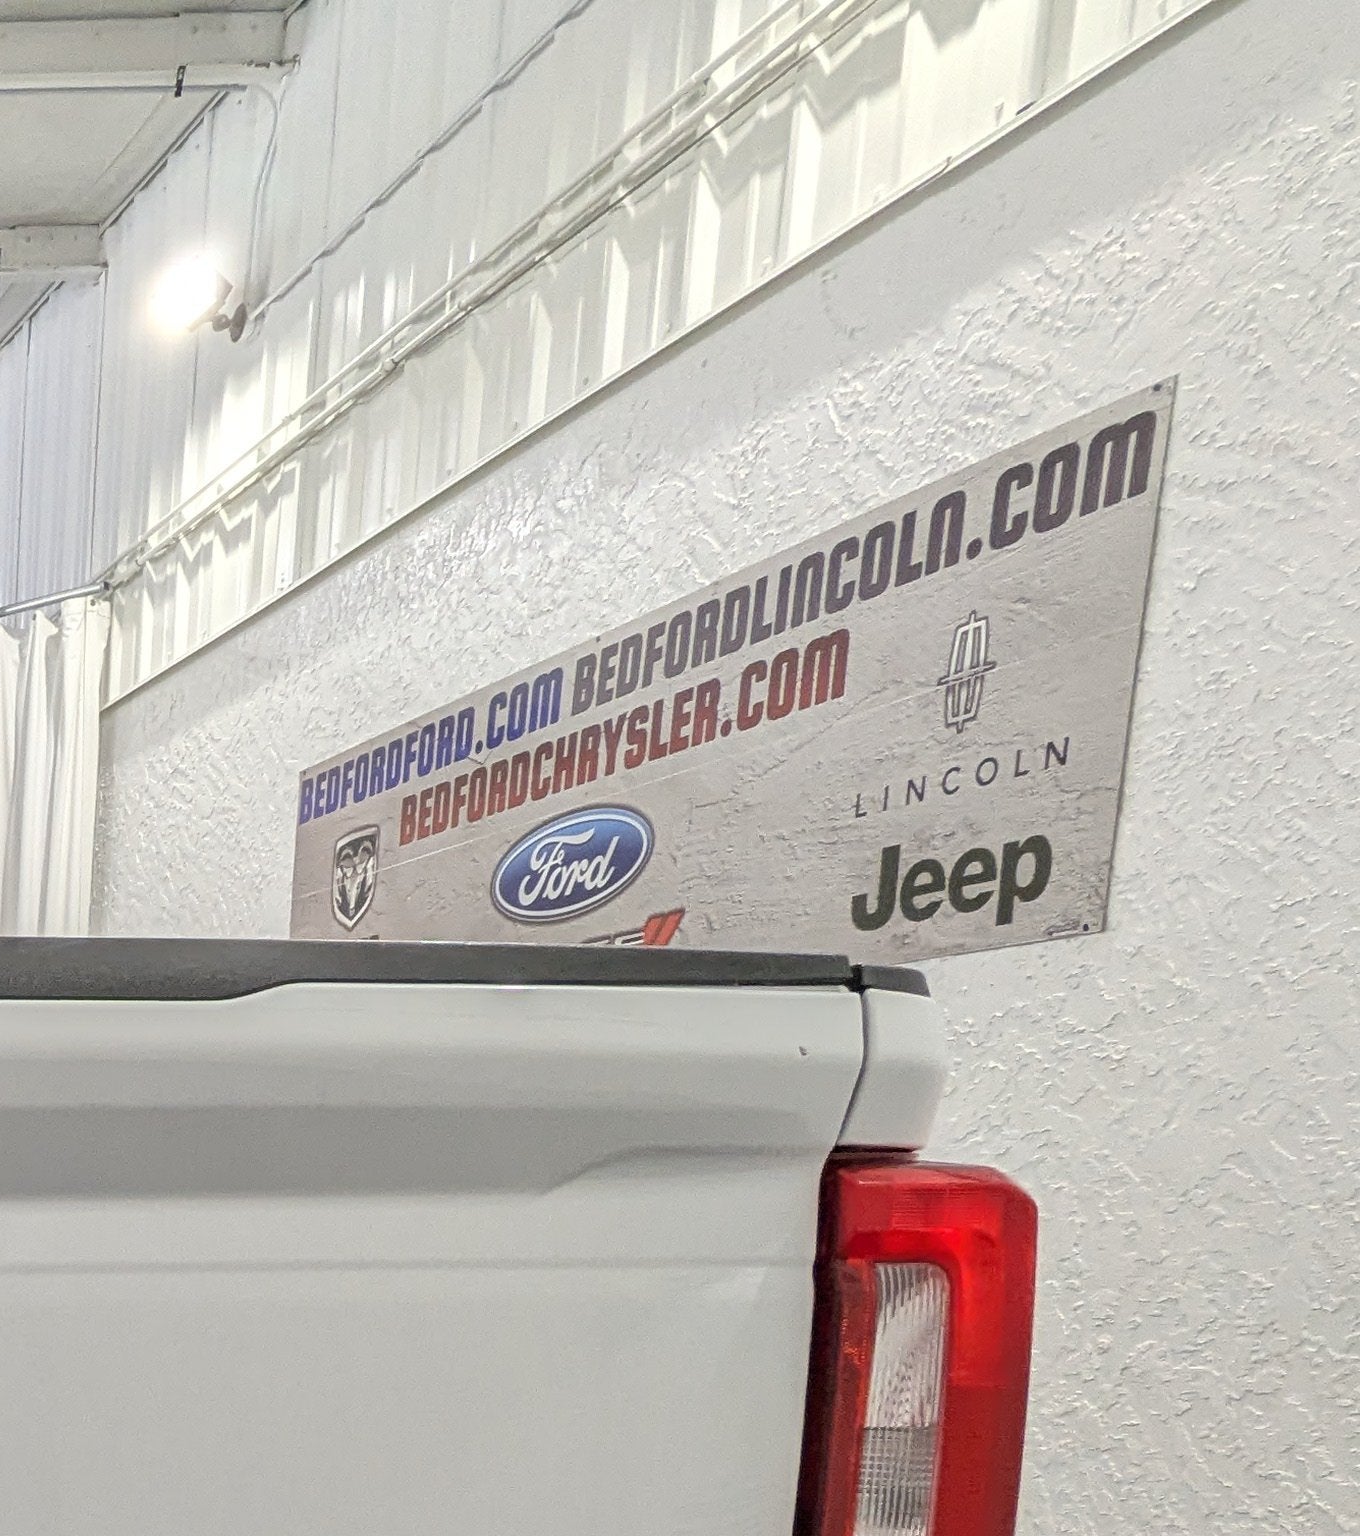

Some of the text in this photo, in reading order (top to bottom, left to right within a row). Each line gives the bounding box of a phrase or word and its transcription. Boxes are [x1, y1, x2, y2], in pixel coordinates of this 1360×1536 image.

[299, 410, 1157, 826] BEDFORDFORD.COM BEDFORDLINCOLN.COM
[398, 628, 850, 847] BEDFORDCHRYSLER.COM
[854, 736, 1070, 819] LINCOLN
[517, 827, 622, 907] Ford
[850, 834, 1053, 932] Jeep
